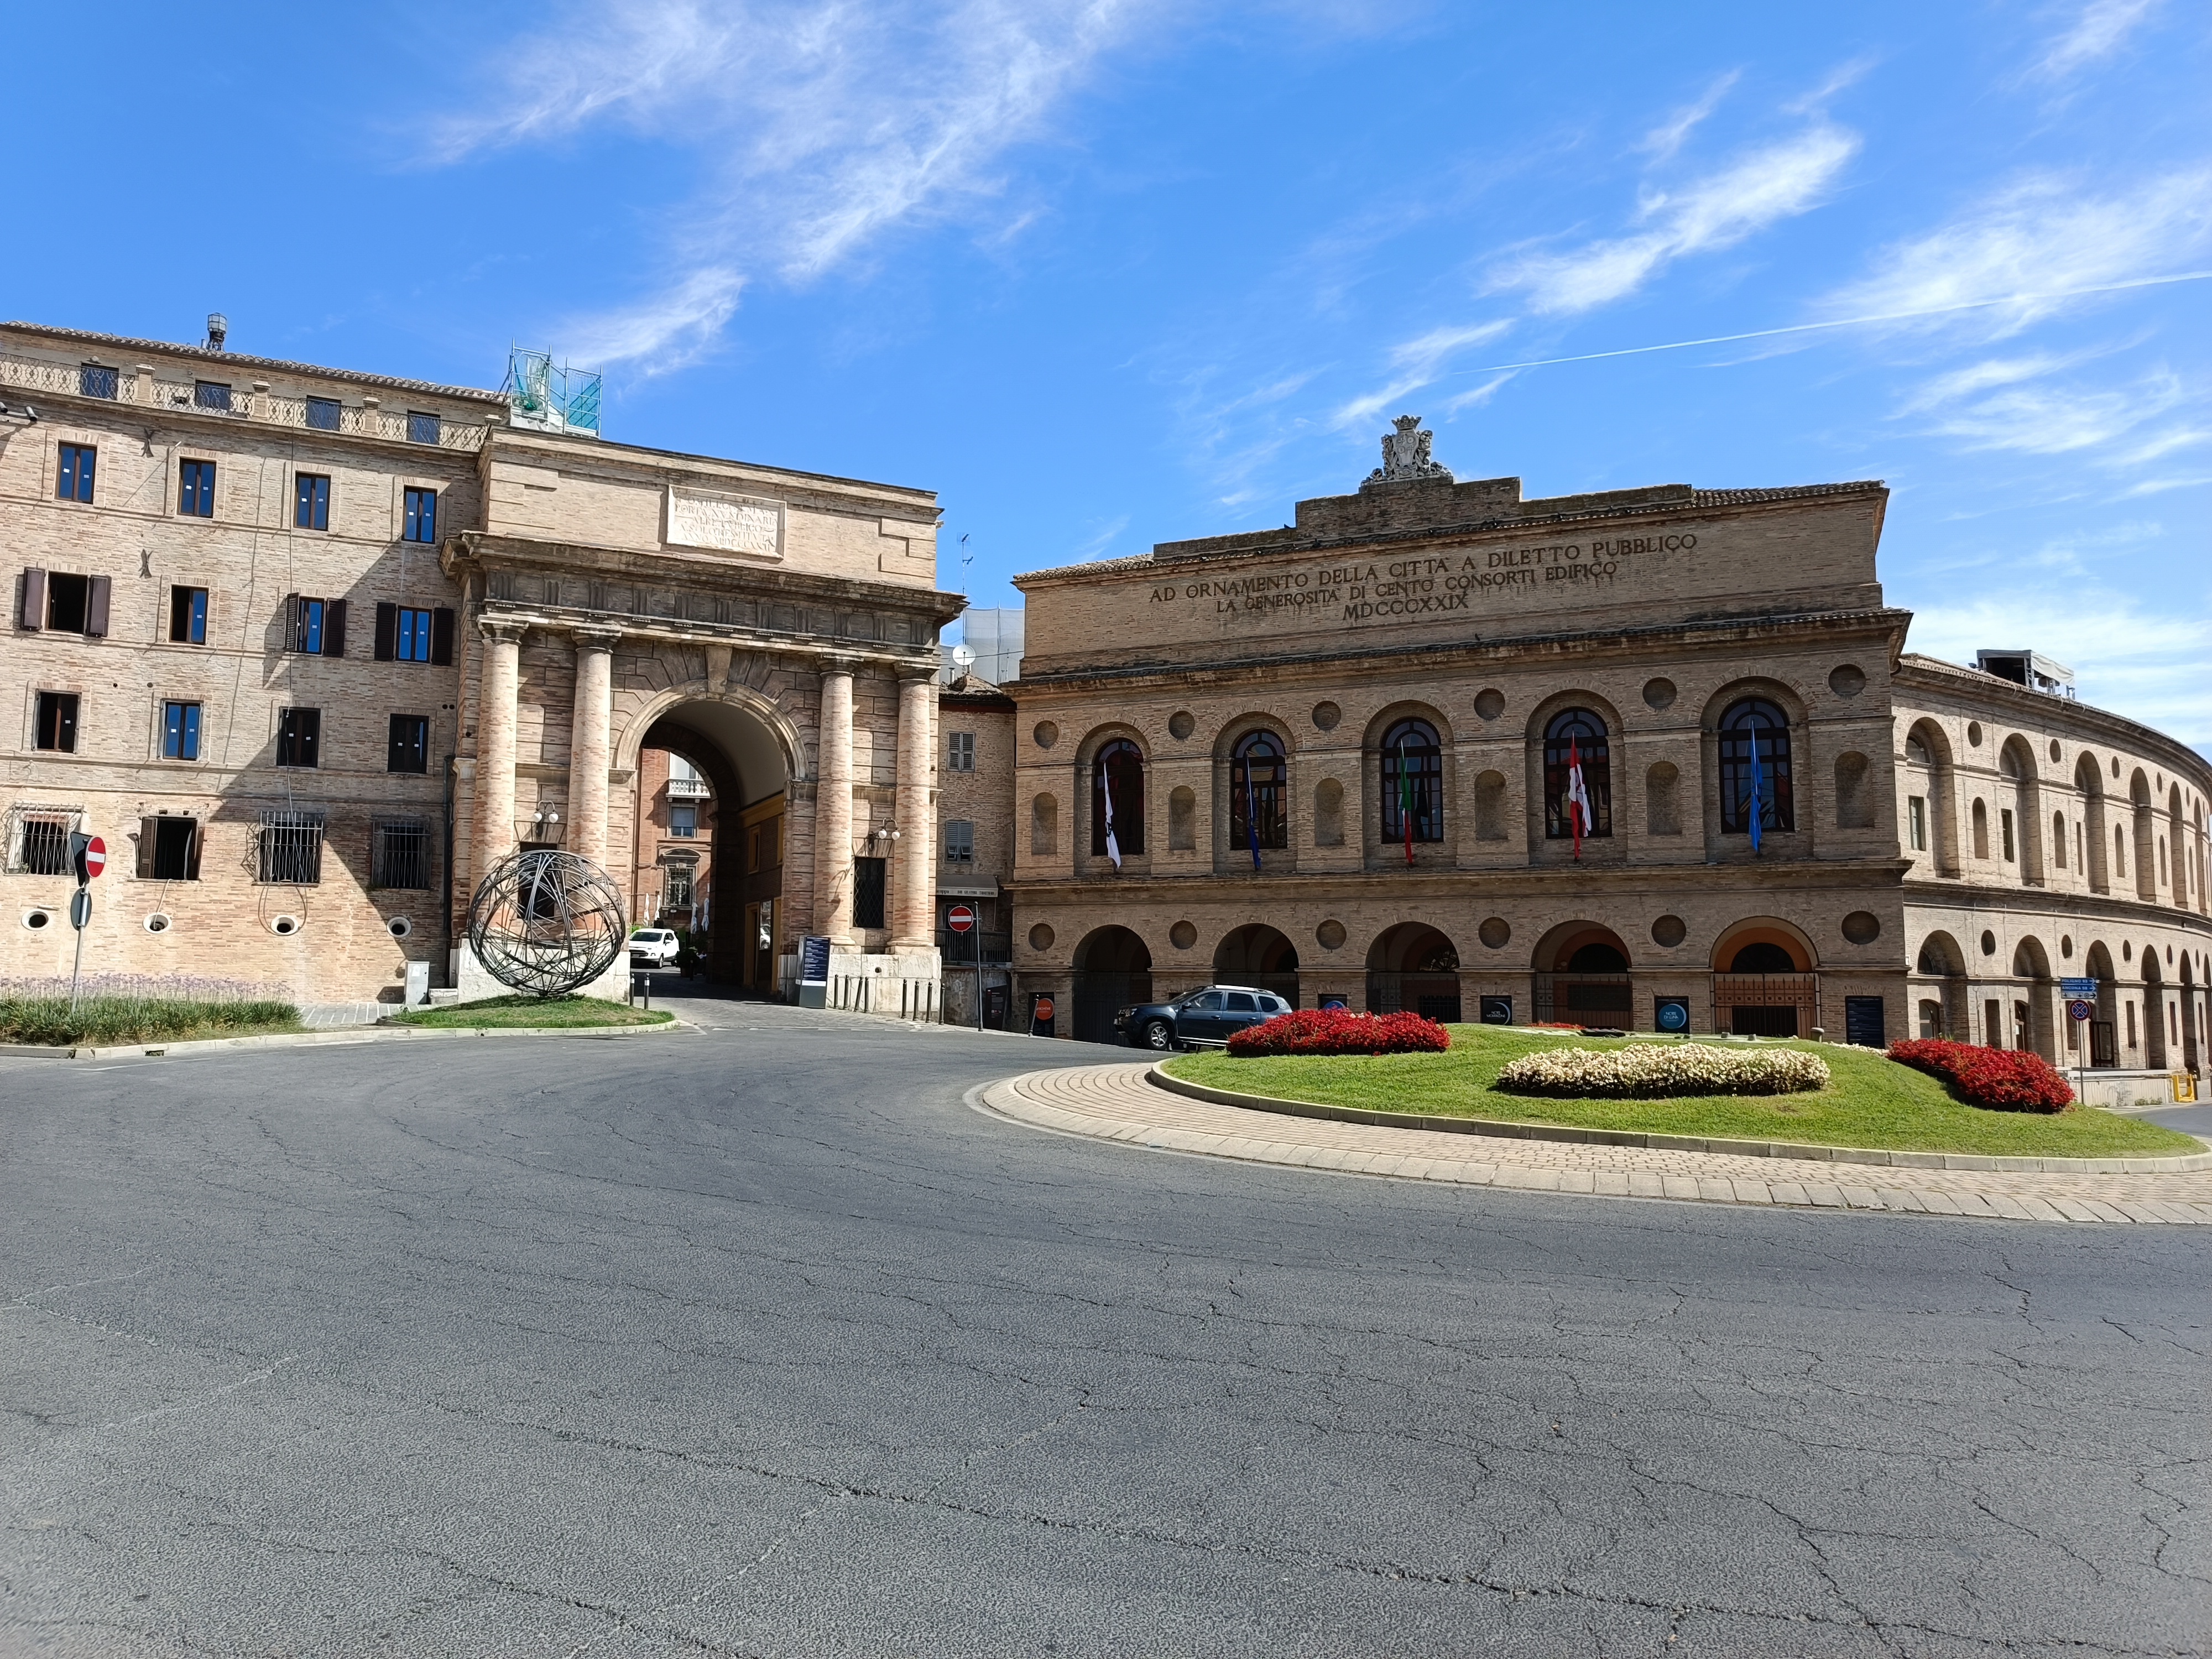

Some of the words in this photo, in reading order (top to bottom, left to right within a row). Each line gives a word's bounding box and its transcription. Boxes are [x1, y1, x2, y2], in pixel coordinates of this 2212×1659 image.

[1149, 587, 1176, 602] AD
[1186, 573, 1308, 598] ORNAMENTO
[1319, 565, 1378, 585] DELLA
[1461, 556, 1476, 571] A
[1488, 545, 1580, 568] DILETTO
[1592, 534, 1697, 558] PUBBLICO
[1217, 599, 1237, 613] LA
[1349, 586, 1365, 600] DI
[1375, 579, 1434, 597] CENTO
[1445, 569, 1535, 590] CONSORTI
[1343, 593, 1469, 621] MDCCCXXIX
